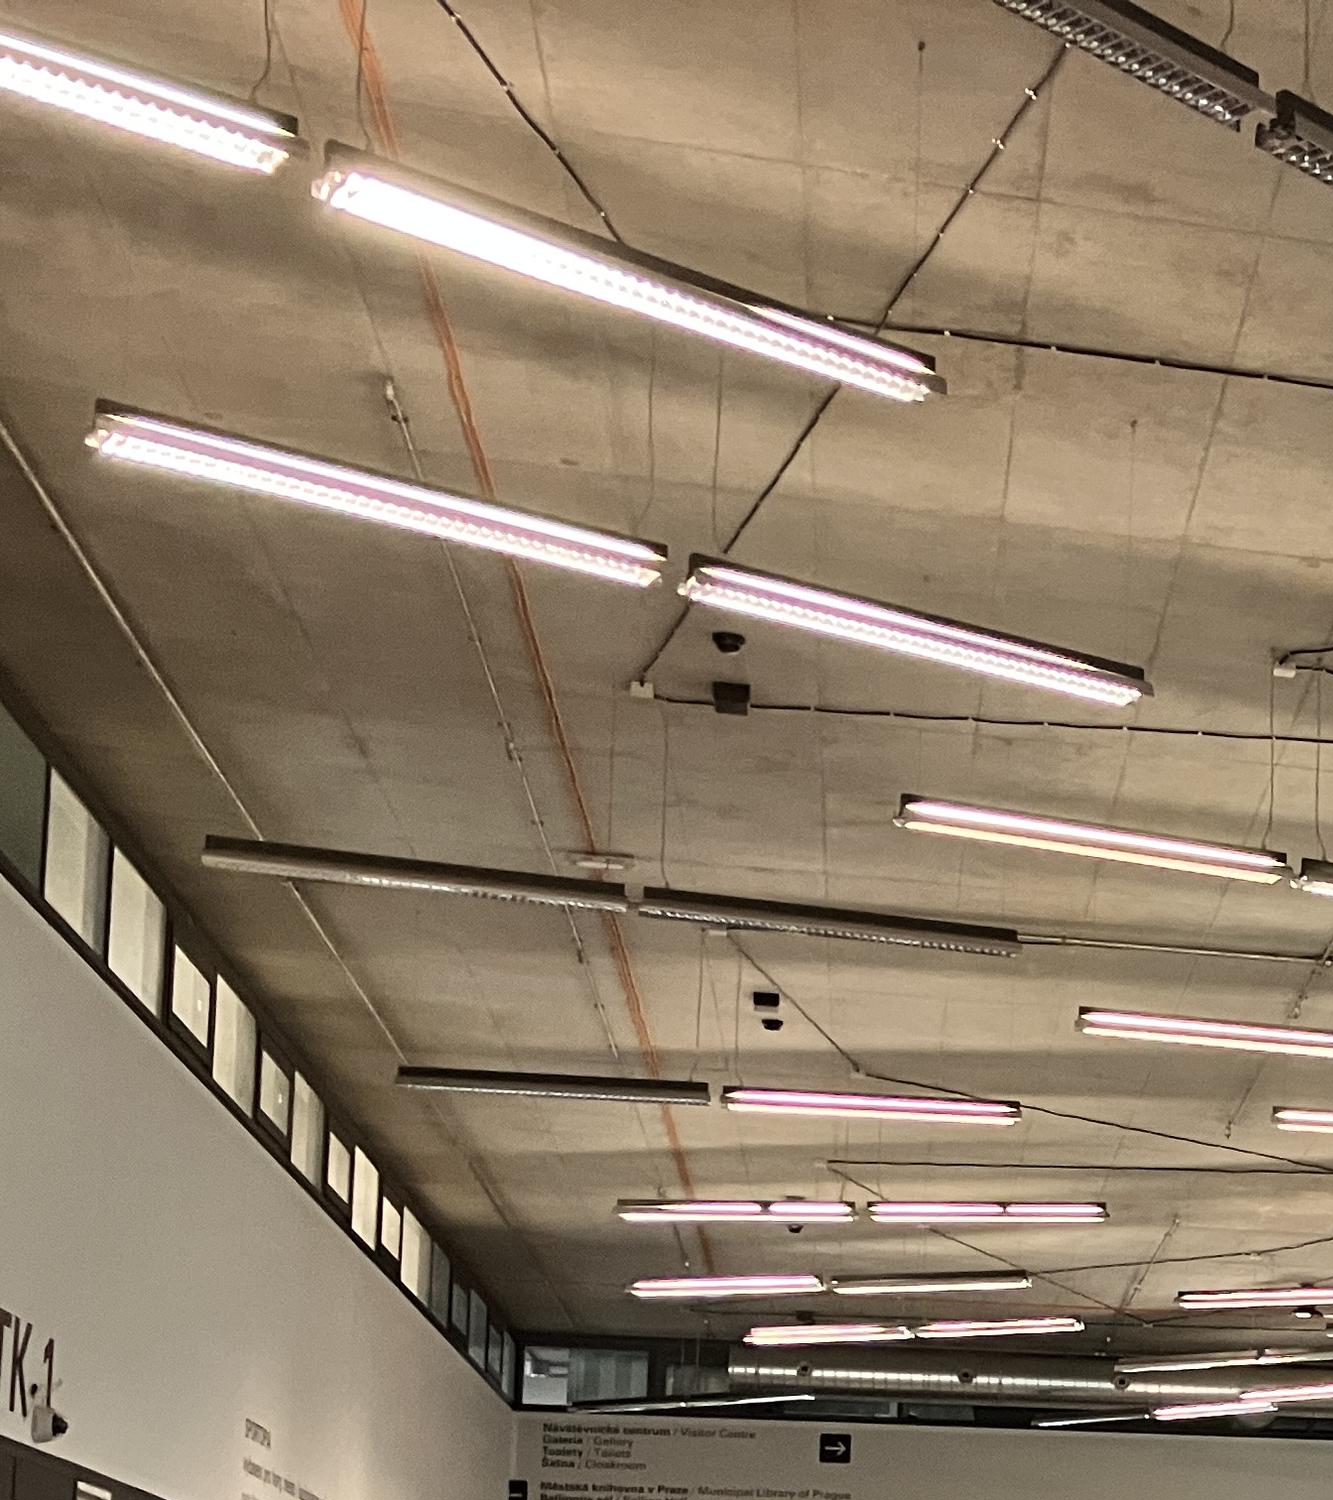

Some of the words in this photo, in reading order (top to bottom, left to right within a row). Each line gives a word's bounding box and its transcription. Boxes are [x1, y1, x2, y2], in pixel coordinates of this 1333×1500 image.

[592, 1483, 645, 1494] knihovna
[658, 1485, 689, 1494] Praze
[756, 1488, 796, 1500] Library
